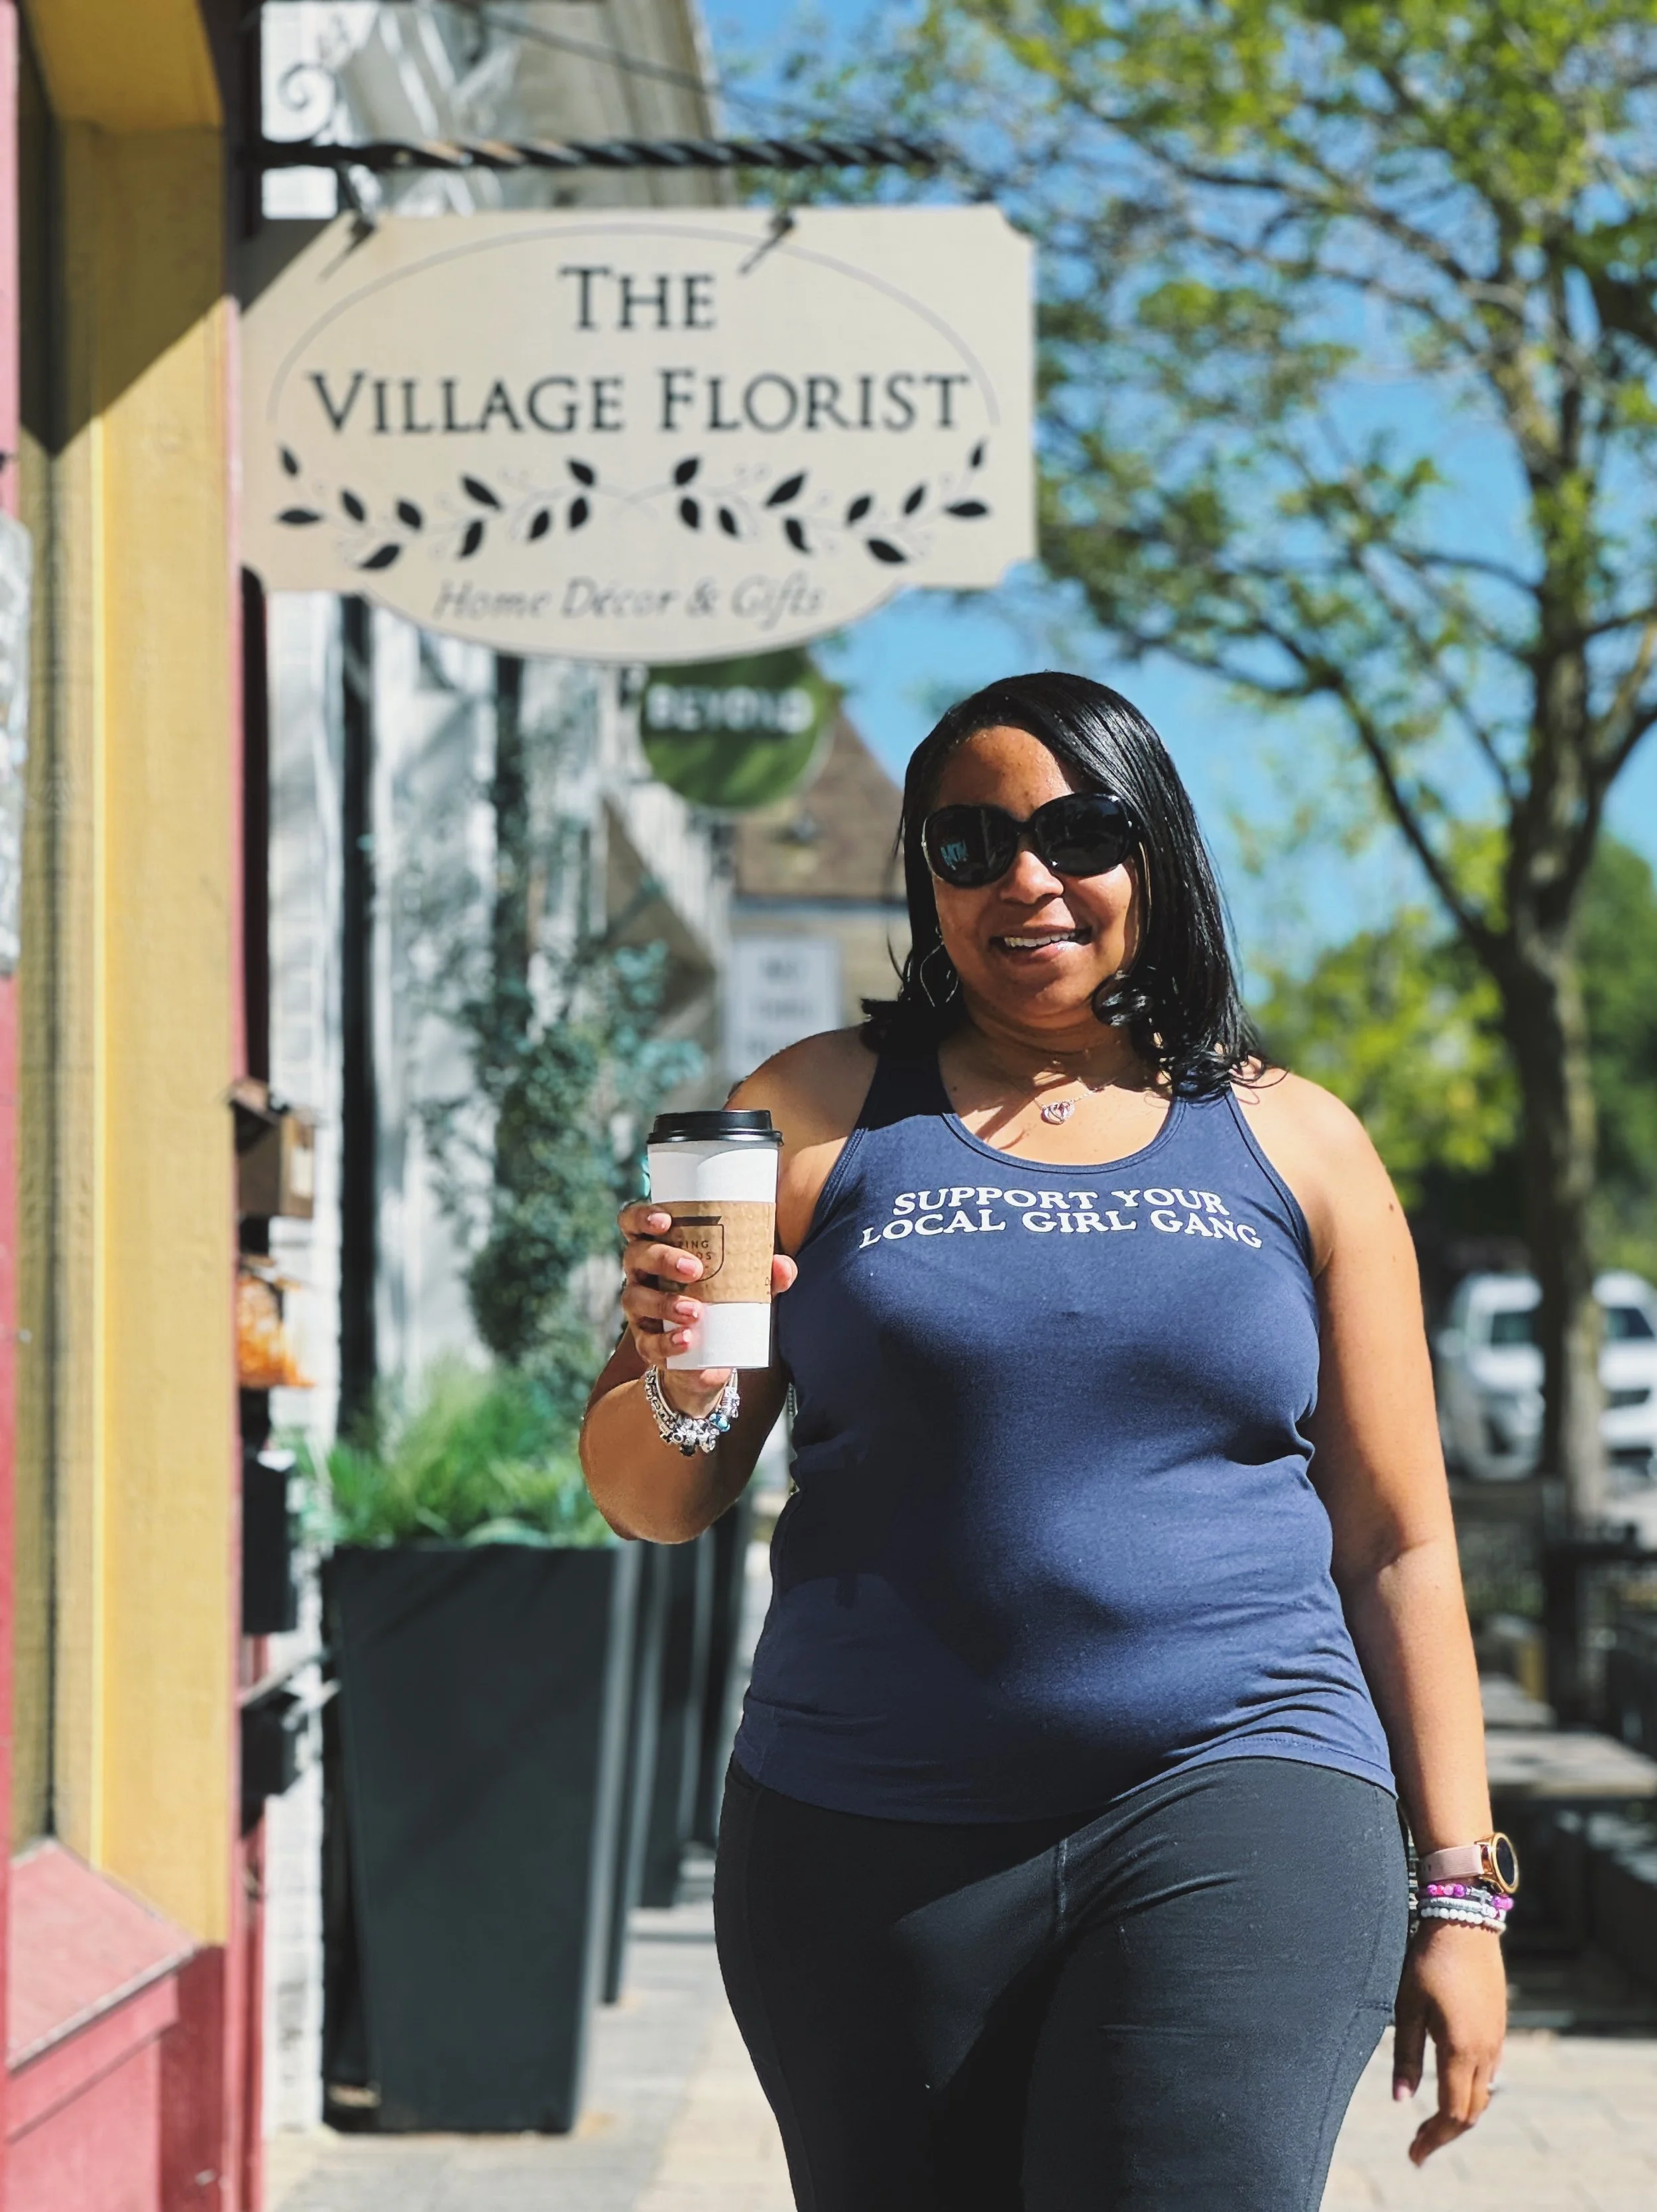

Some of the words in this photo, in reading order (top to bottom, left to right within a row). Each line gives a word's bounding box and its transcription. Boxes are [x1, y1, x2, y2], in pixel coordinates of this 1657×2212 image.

[559, 265, 714, 331] THE
[308, 370, 624, 435] VILLAGE
[658, 368, 969, 433] FLORIST
[431, 578, 553, 621] Home
[684, 575, 720, 619] &
[730, 568, 825, 630] Gifts
[858, 1209, 1006, 1248] LOCAL
[1021, 1210, 1137, 1233] GIRL
[1149, 1209, 1263, 1248] GANG
[892, 1187, 1099, 1215] SUPPORT
[1110, 1188, 1230, 1216] YOUR
